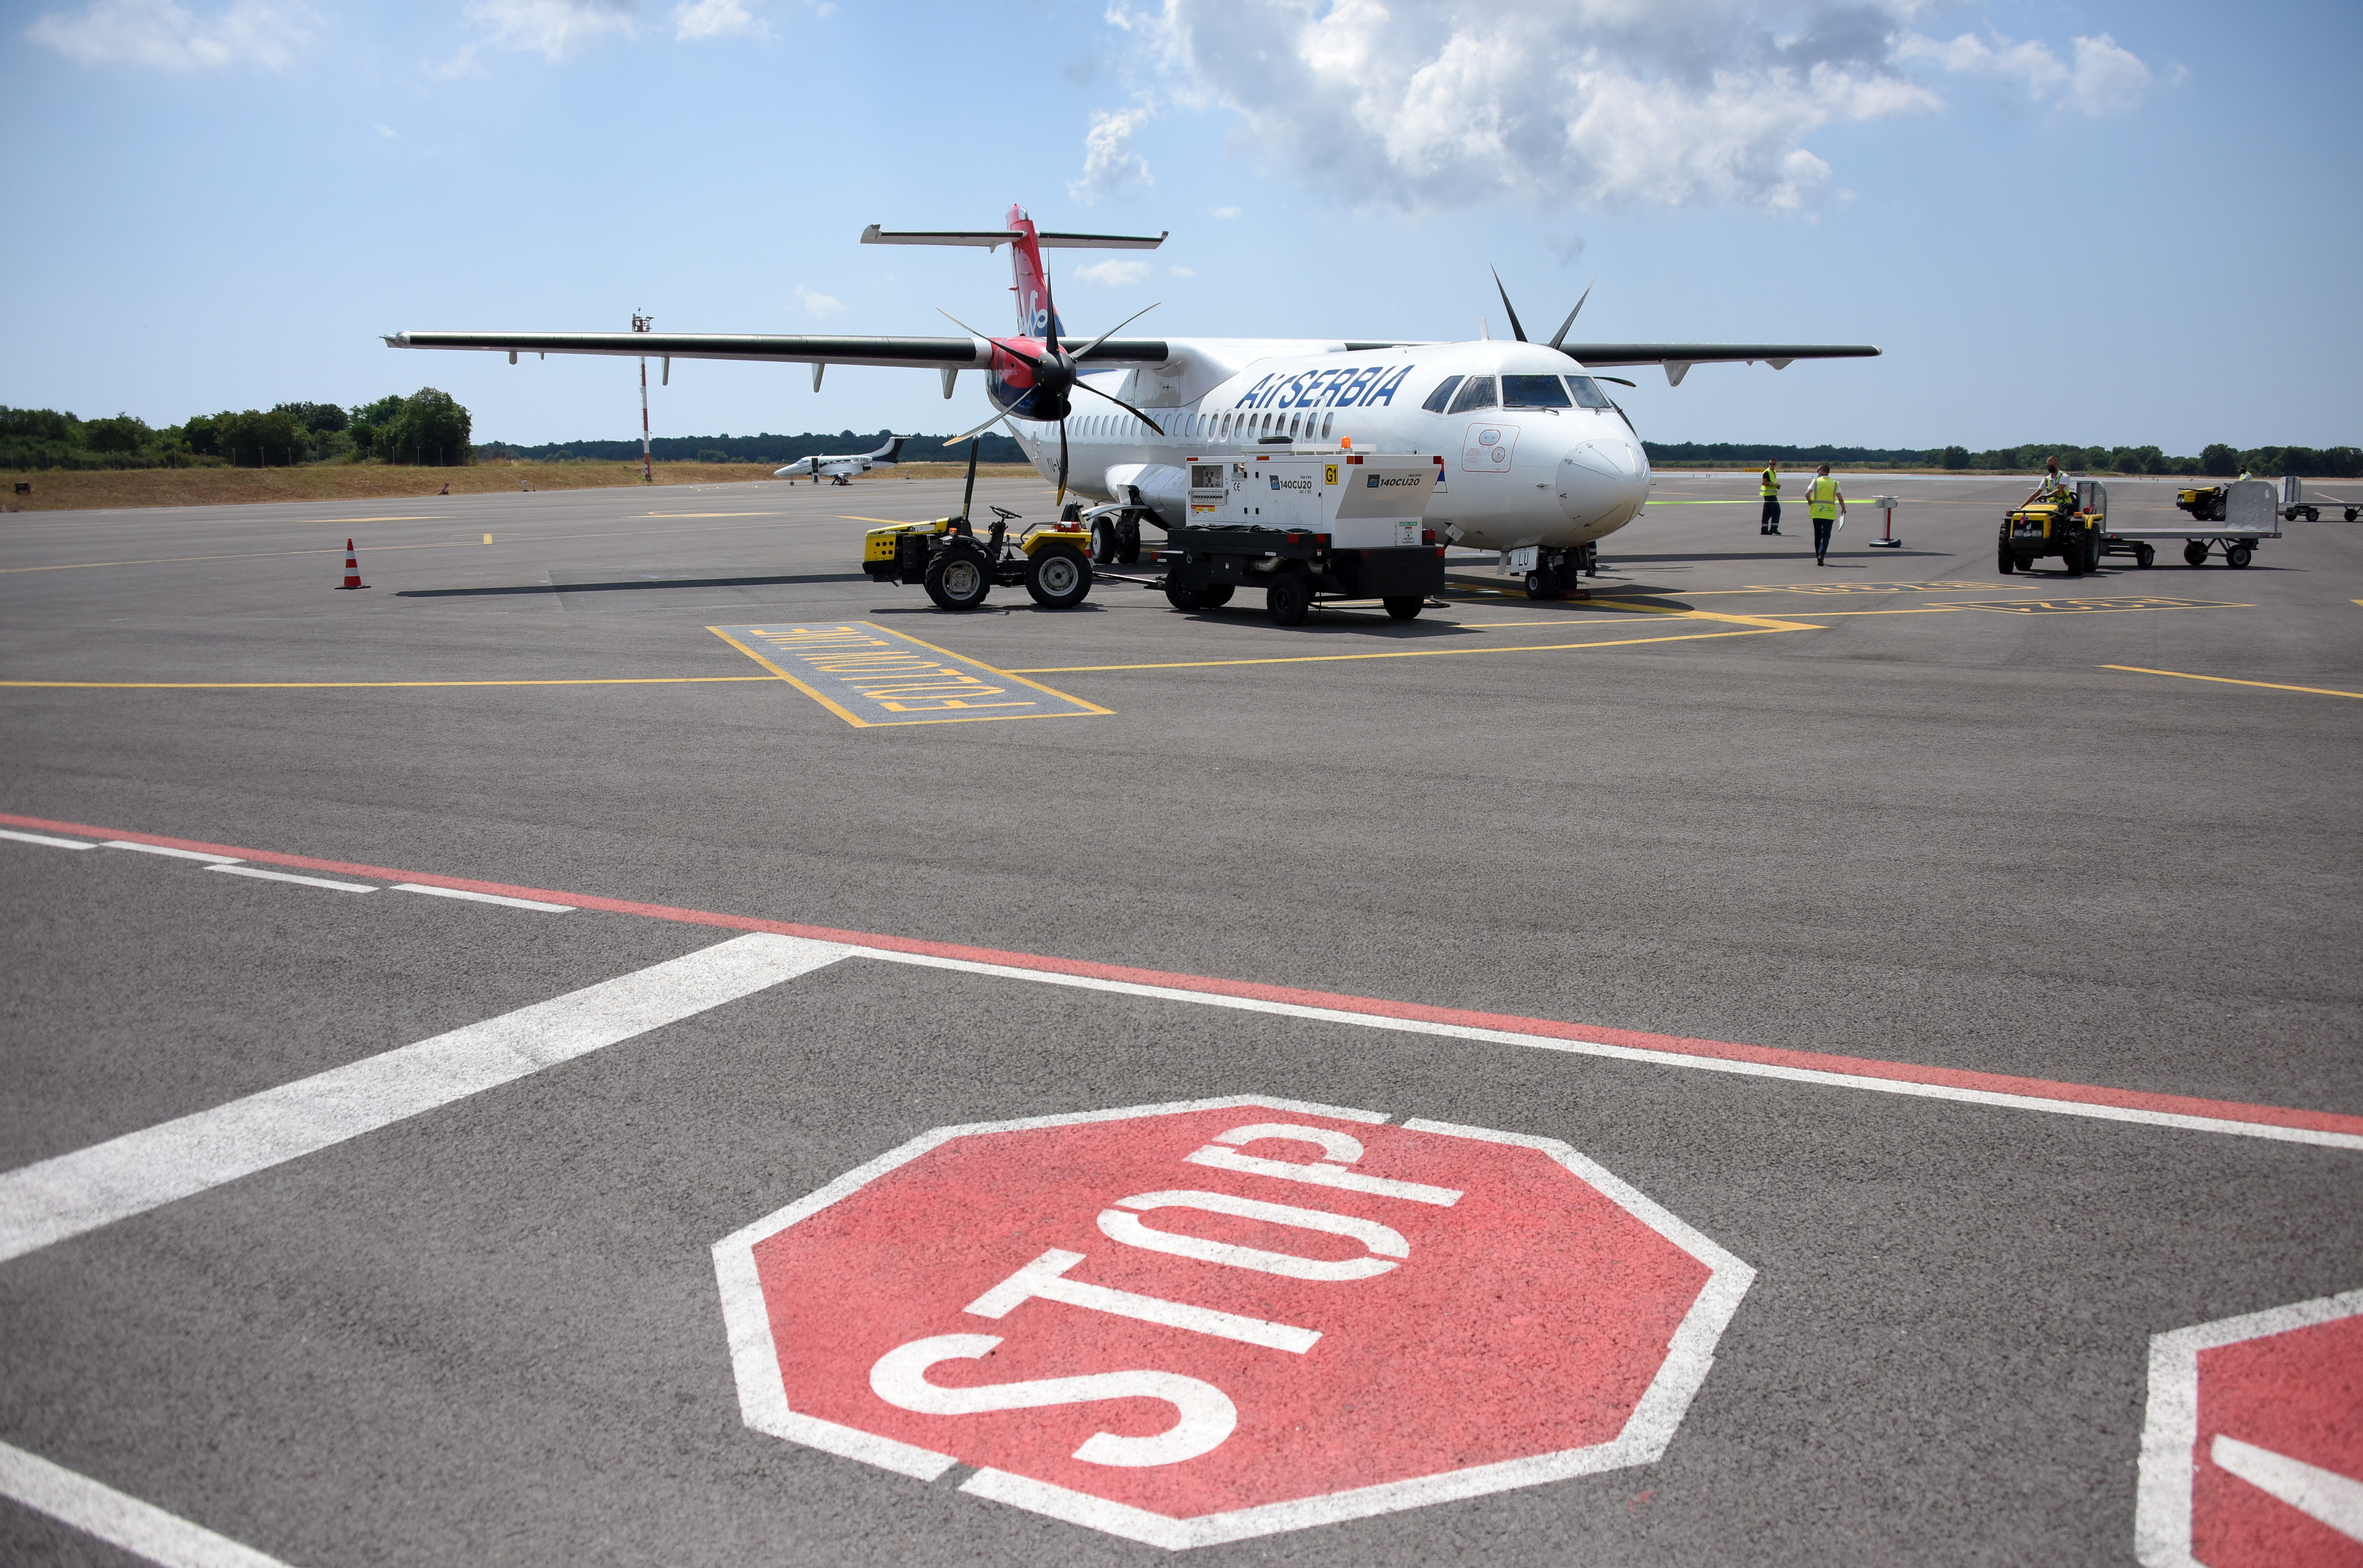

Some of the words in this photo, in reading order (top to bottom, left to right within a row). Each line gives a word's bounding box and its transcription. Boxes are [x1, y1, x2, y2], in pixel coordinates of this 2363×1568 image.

[1326, 467, 1336, 483] G1
[1280, 480, 1312, 489] 140CU20
[1518, 552, 1529, 567] LU
[796, 651, 1037, 712] FOLLOW
[869, 1121, 1464, 1468] STOP
